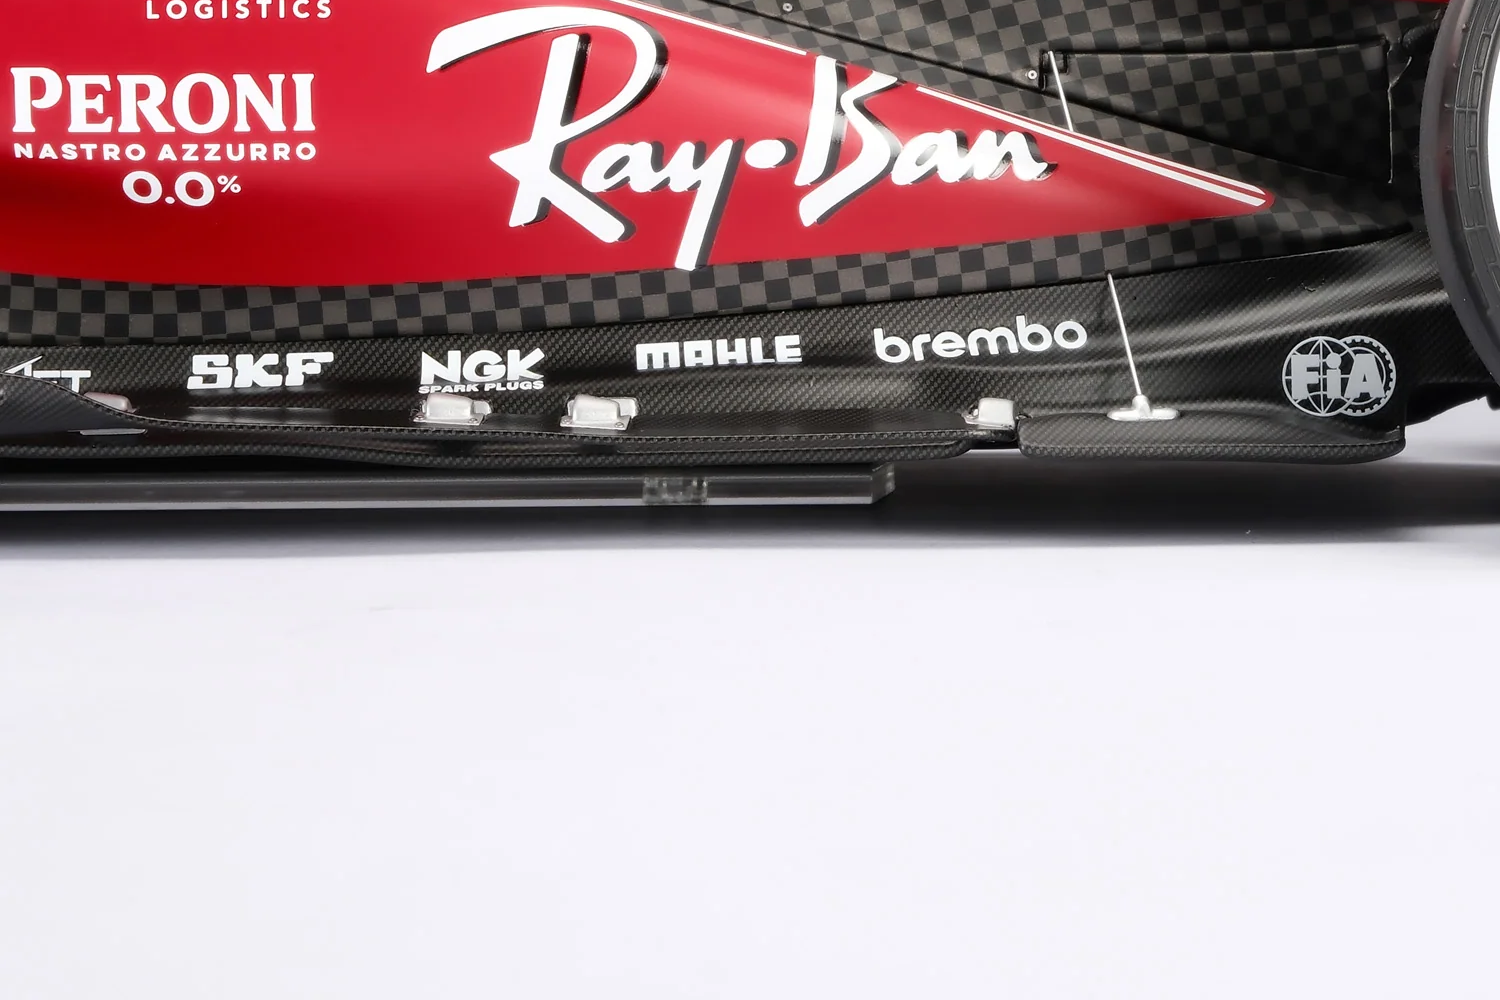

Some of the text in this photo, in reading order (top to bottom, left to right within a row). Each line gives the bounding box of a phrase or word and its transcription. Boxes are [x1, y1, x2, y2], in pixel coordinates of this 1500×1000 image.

[146, 0, 332, 20] LOGISTICS
[10, 66, 316, 133] PERONI
[14, 142, 317, 162] NASTRO AZZURRO
[635, 334, 803, 371] MAHLE
[873, 315, 1088, 363] brembo
[187, 352, 334, 390] SKF
[420, 348, 545, 385] NGK
[418, 380, 545, 394] SPARK PLUGS
